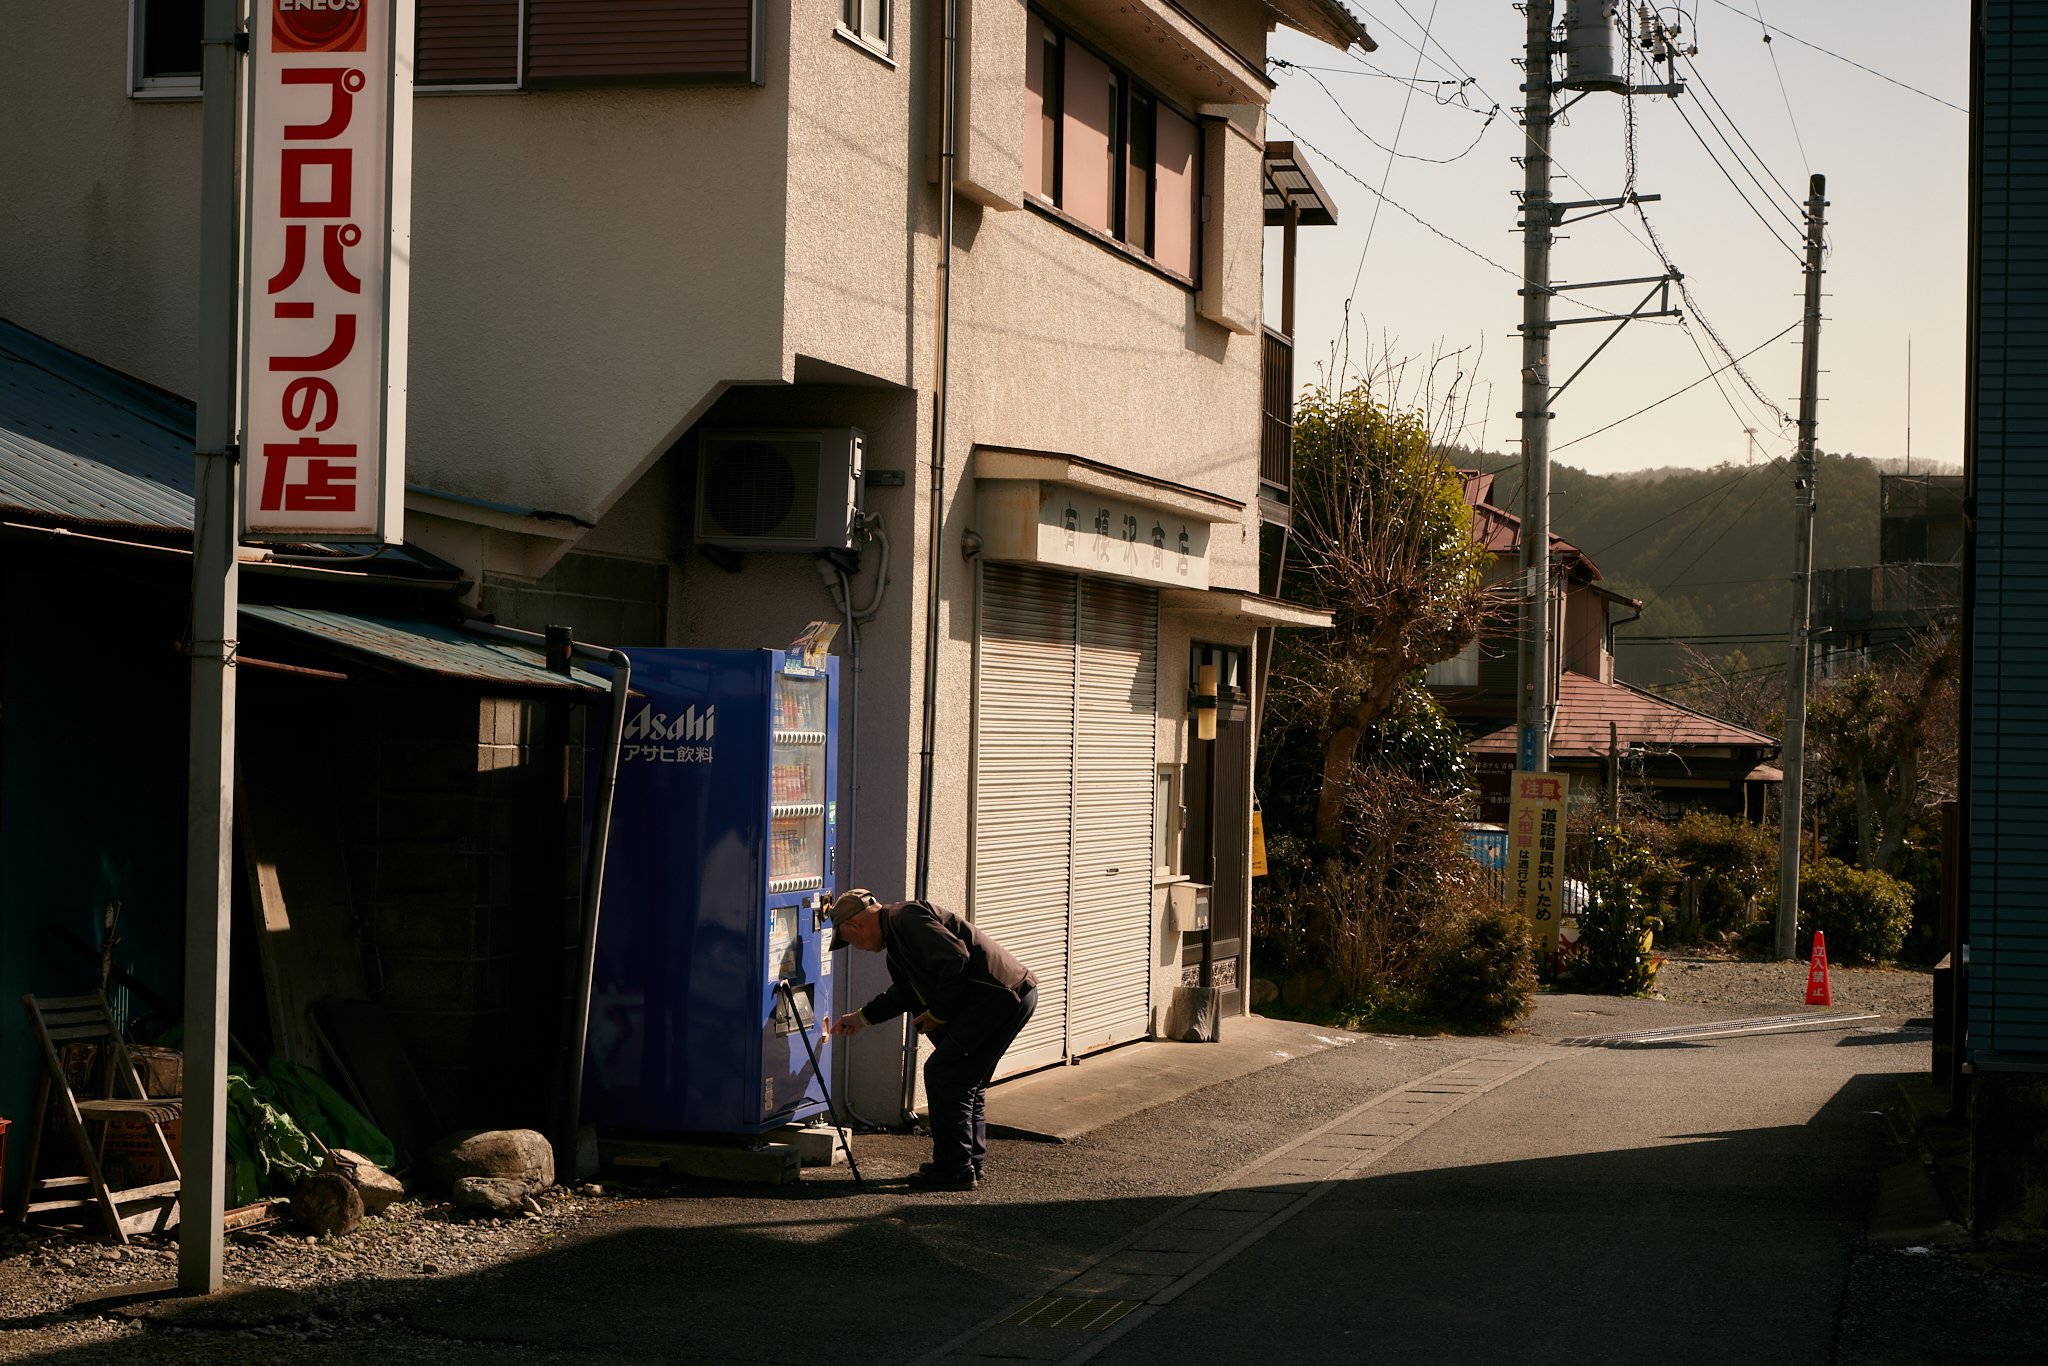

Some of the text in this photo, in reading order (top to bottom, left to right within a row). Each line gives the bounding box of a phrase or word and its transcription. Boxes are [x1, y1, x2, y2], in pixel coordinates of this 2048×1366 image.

[280, 0, 361, 11] ENEOS
[260, 68, 366, 511] プロパンの店
[623, 703, 716, 742] Asahi
[623, 744, 714, 764] アサヒ飲料
[1527, 783, 1554, 797] 注意
[1517, 807, 1534, 898] 大型車は通行でき
[1536, 808, 1557, 921] 道路幅員狭いため
[1812, 946, 1825, 997] 立入禁止
